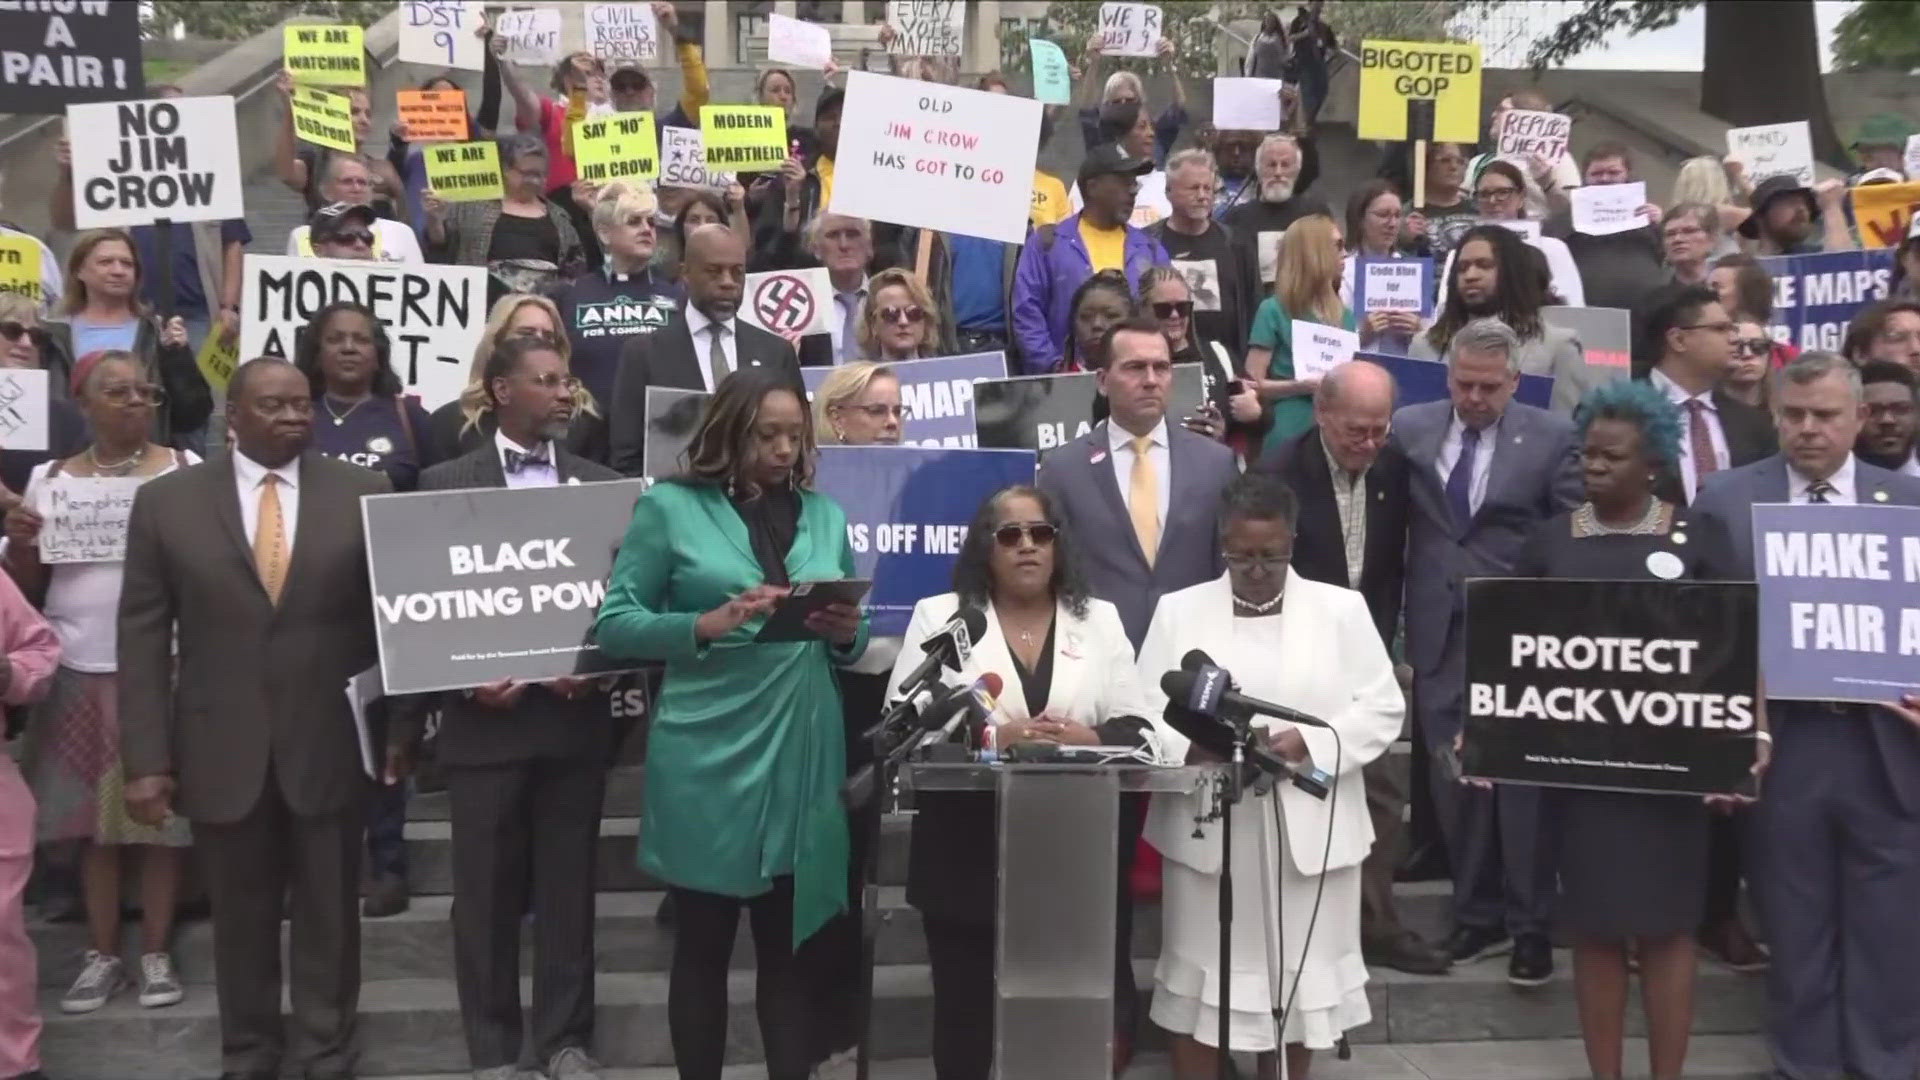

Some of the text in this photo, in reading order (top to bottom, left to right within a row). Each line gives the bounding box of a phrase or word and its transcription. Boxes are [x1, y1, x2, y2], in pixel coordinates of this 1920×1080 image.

[404, 2, 465, 28] DST
[591, 6, 642, 25] CIVIL
[1102, 6, 1157, 28] WE R
[44, 15, 76, 48] A
[298, 30, 349, 43] WE ARE
[596, 25, 650, 43] RIGHTS
[901, 19, 951, 38] VOTE
[433, 31, 454, 64] 9
[594, 40, 656, 60] FOREVER
[891, 34, 960, 54] MATTERS
[1140, 30, 1150, 52] 9
[288, 56, 361, 71] WATCHING
[1362, 48, 1473, 74] BIGOTED
[1394, 75, 1449, 97] GOP
[918, 97, 953, 113] OLD
[117, 103, 179, 136] NO
[582, 122, 607, 139] SAY
[713, 113, 773, 129] MODERN
[884, 122, 980, 150] JIM CROW
[108, 137, 188, 174] JIM
[435, 147, 486, 164] WE ARE
[610, 145, 621, 155] TO
[706, 146, 784, 164] APARTHEID
[582, 158, 653, 182] JIM CROW
[872, 150, 1004, 184] HAS GOT TO GO
[84, 172, 216, 211] CROW
[431, 172, 499, 190] WATCHING
[1804, 269, 1891, 306] MAPS
[258, 269, 470, 330] MODERN
[581, 305, 664, 324] ANNA
[583, 327, 605, 339] FOR
[876, 523, 918, 554] OFF
[449, 537, 576, 576] BLACK
[1765, 531, 1892, 581] MAKE
[376, 586, 523, 624] VOTING
[1790, 602, 1887, 654] FAIR
[1511, 635, 1699, 674] PROTECT
[1470, 683, 1754, 731] BLACK VOTES
